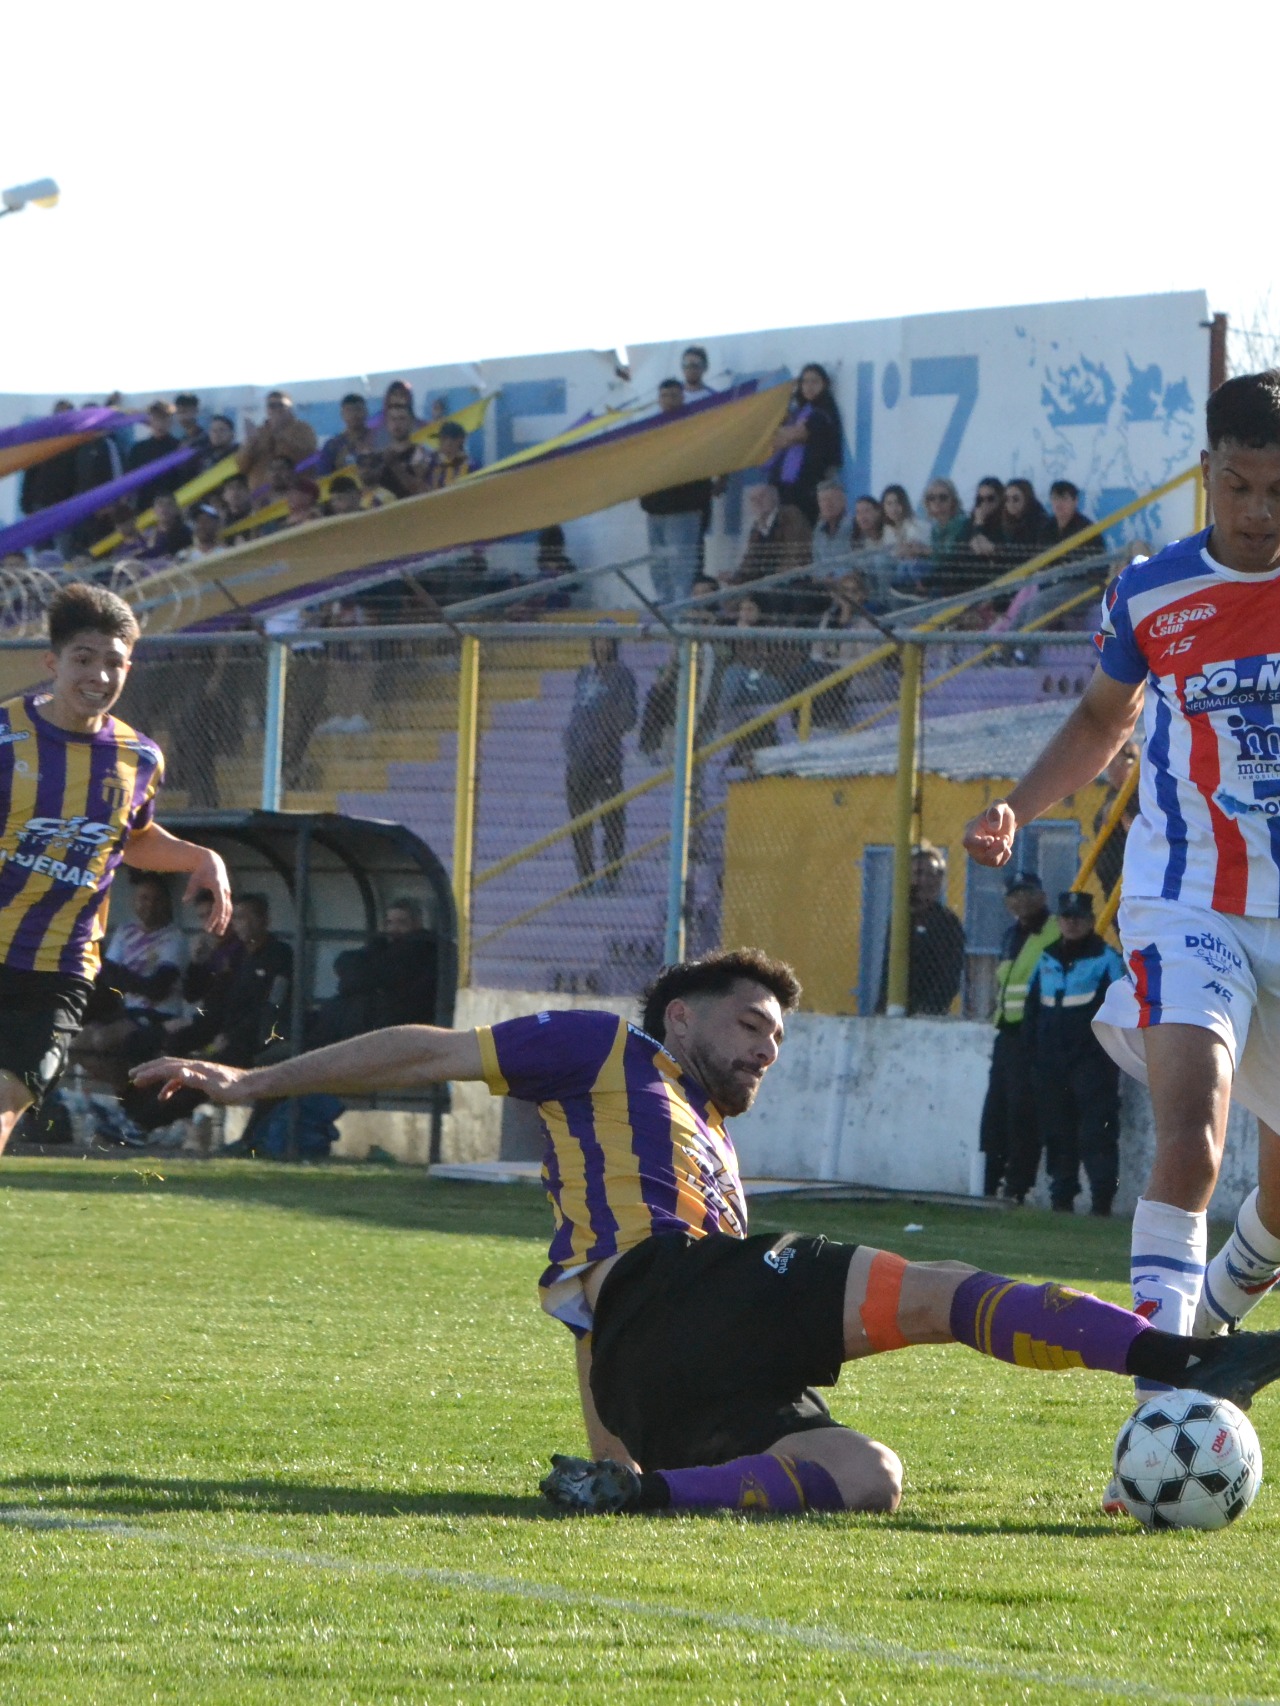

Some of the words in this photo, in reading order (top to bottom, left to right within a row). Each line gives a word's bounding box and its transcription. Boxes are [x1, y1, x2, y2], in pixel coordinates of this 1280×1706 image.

[1156, 607, 1216, 627] PESOS
[1186, 692, 1254, 713] NEUMATICOS
[1258, 692, 1266, 701] Y
